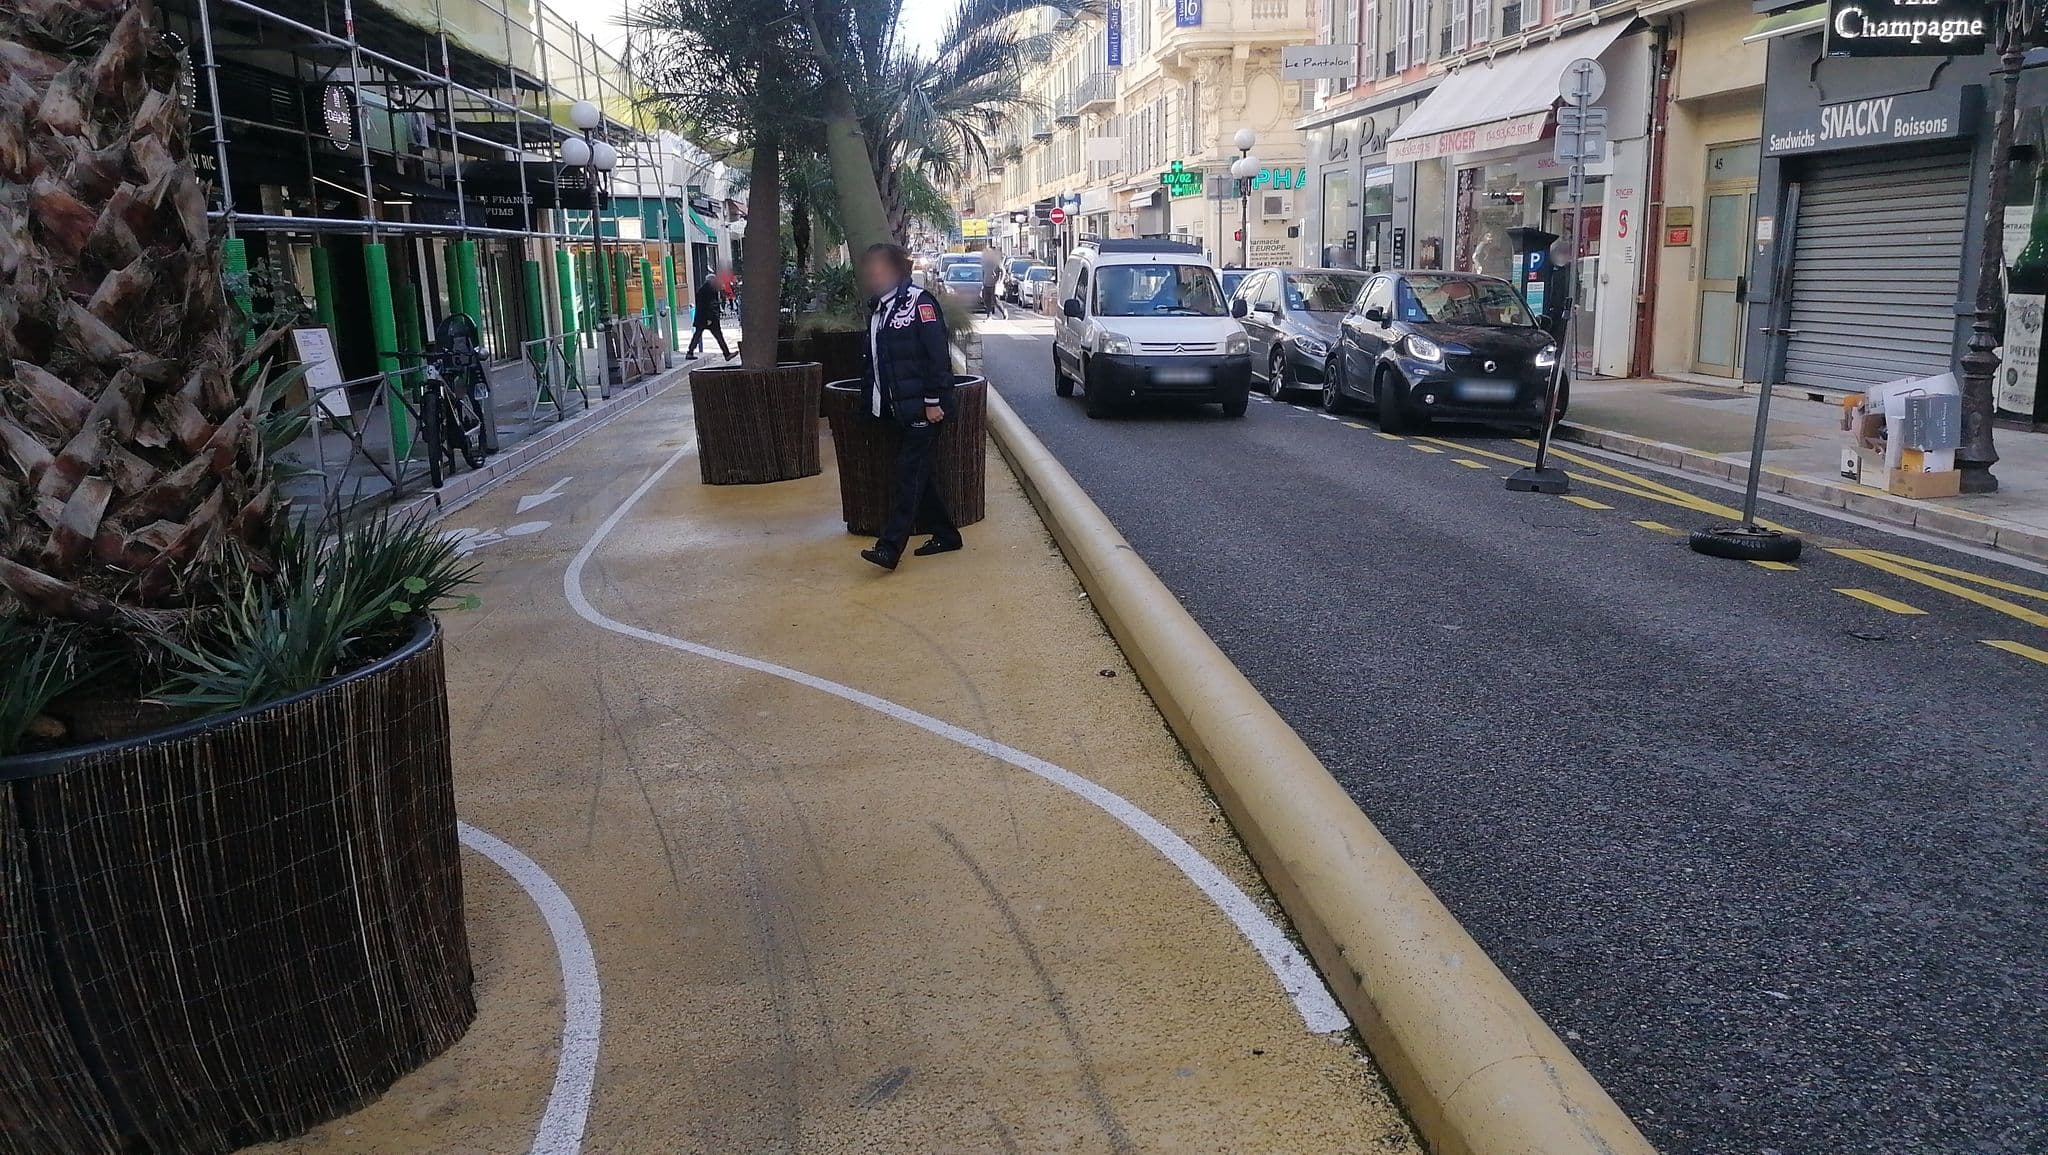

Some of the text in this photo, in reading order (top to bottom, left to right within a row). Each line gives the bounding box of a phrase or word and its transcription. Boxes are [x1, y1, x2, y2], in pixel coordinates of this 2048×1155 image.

[1834, 6, 1984, 45] Champagne
[1285, 56, 1349, 68] Le Pantalon
[1770, 98, 1948, 151] Sandwichs SNACKY Boissons
[1329, 121, 1349, 161] Le
[1439, 131, 1477, 154] SINGER
[1163, 174, 1192, 184] 10/02
[1255, 244, 1286, 252] EUROPE
[1530, 252, 1540, 269] P
